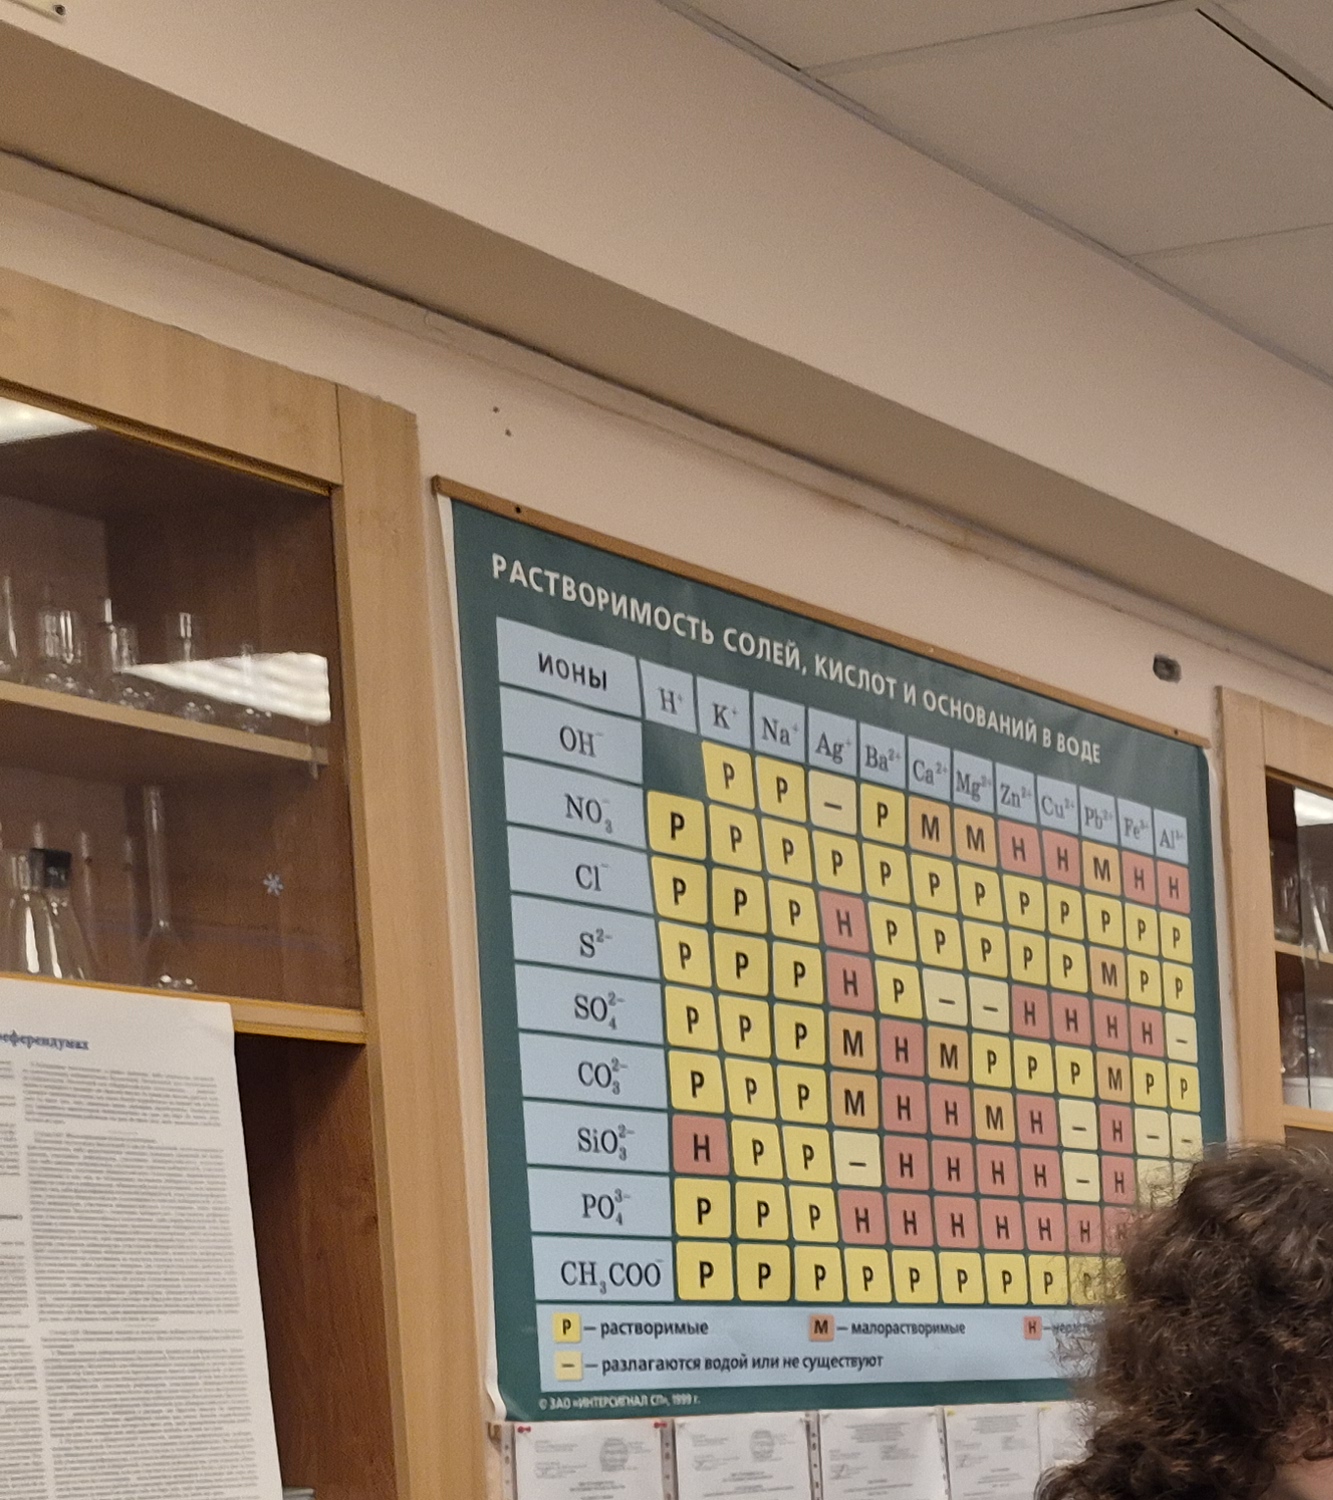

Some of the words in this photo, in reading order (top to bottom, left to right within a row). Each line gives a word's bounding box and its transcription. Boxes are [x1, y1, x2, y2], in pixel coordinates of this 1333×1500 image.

[491, 553, 714, 644] РАСТВОРИМОСТЬ
[723, 627, 807, 675] СОЛЕЙ,
[814, 654, 897, 696] КИСЛОТ
[903, 682, 917, 704] И
[922, 691, 1038, 742] ОСНОВАНИЙ
[1042, 730, 1052, 748] В
[1056, 733, 1101, 764] ВОДЕ
[722, 761, 735, 789] Р
[775, 775, 789, 803] Р
[876, 801, 889, 828] Р
[921, 813, 940, 841] М
[965, 824, 985, 853] М
[1011, 835, 1027, 863] Н
[1056, 846, 1069, 873] Н
[1093, 856, 1111, 882] М
[1133, 867, 1145, 891] Н
[1168, 875, 1180, 900] Н
[670, 811, 685, 840] Р
[729, 825, 743, 853] Р
[781, 837, 795, 865] Р
[831, 849, 843, 876] Р
[879, 861, 892, 887] Р
[928, 871, 941, 897] Р
[974, 881, 986, 907] Р
[1019, 891, 1031, 915] Р
[1060, 900, 1070, 925] Р
[1101, 909, 1111, 933] Р
[1137, 918, 1147, 942] Р
[1171, 926, 1181, 949] Р
[672, 877, 687, 905] Р
[733, 887, 748, 916] Р
[788, 899, 801, 927] Р
[835, 909, 853, 938] Н
[885, 919, 898, 945] Р
[933, 928, 946, 955] Р
[980, 937, 992, 963] Р
[1023, 945, 1033, 971] Р
[1062, 953, 1073, 979] Р
[1101, 961, 1118, 987] М
[1139, 969, 1149, 993] Р
[1174, 976, 1183, 999] Р
[678, 941, 692, 970] Р
[735, 951, 749, 979] Р
[793, 960, 806, 988] Р
[842, 969, 859, 997] Н
[892, 977, 905, 1003] Р
[1023, 1000, 1037, 1027] Н
[1065, 1007, 1079, 1033] Н
[1106, 1015, 1119, 1039] Н
[1141, 1021, 1153, 1045] Н
[685, 1005, 699, 1035] Р
[738, 1014, 752, 1043] Р
[794, 1022, 808, 1050] Р
[843, 1029, 863, 1057] М
[894, 1035, 909, 1063] Н
[939, 1043, 958, 1069] М
[986, 1049, 997, 1075] Р
[1027, 1055, 1038, 1080] Р
[1070, 1061, 1081, 1085] Р
[1107, 1066, 1123, 1091] М
[1145, 1072, 1155, 1095] Р
[1179, 1077, 1188, 1100] Р
[690, 1070, 705, 1099] Р
[744, 1077, 758, 1105] Р
[797, 1083, 810, 1111] Р
[844, 1089, 865, 1117] М
[896, 1094, 911, 1121] Н
[944, 1100, 959, 1126] Н
[985, 1104, 1004, 1131] М
[1029, 1109, 1043, 1134] Н
[1111, 1119, 1123, 1143] Н
[693, 1133, 711, 1163] Н
[751, 1139, 765, 1166] Р
[801, 1143, 815, 1171] Р
[899, 1152, 914, 1179] Н
[946, 1156, 961, 1182] Н
[991, 1160, 1005, 1185] Н
[1033, 1163, 1047, 1188] Н
[1113, 1171, 1125, 1194] Н
[696, 1197, 712, 1225] Р
[757, 1199, 770, 1228] Р
[808, 1204, 821, 1231] Р
[854, 1207, 871, 1234] Н
[902, 1209, 918, 1236] Н
[950, 1212, 965, 1238] Н
[995, 1215, 1010, 1240] Н
[1037, 1217, 1053, 1242] Н
[1079, 1220, 1091, 1243] Н
[699, 1261, 714, 1289] Р
[757, 1262, 771, 1290] Р
[814, 1263, 827, 1291] Р
[862, 1265, 874, 1292] Р
[909, 1267, 921, 1293] Р
[956, 1268, 969, 1293] Р
[1001, 1269, 1013, 1294] Р
[1043, 1271, 1054, 1295] Р
[561, 1318, 572, 1336] Р
[601, 1321, 709, 1339] растворимые
[602, 1357, 701, 1376] разлагаются
[704, 1353, 748, 1373] водой
[752, 1356, 780, 1370] или
[783, 1354, 800, 1368] не
[802, 1354, 883, 1373] существуют
[813, 1318, 829, 1334] М
[851, 1322, 966, 1338] малорастворимые
